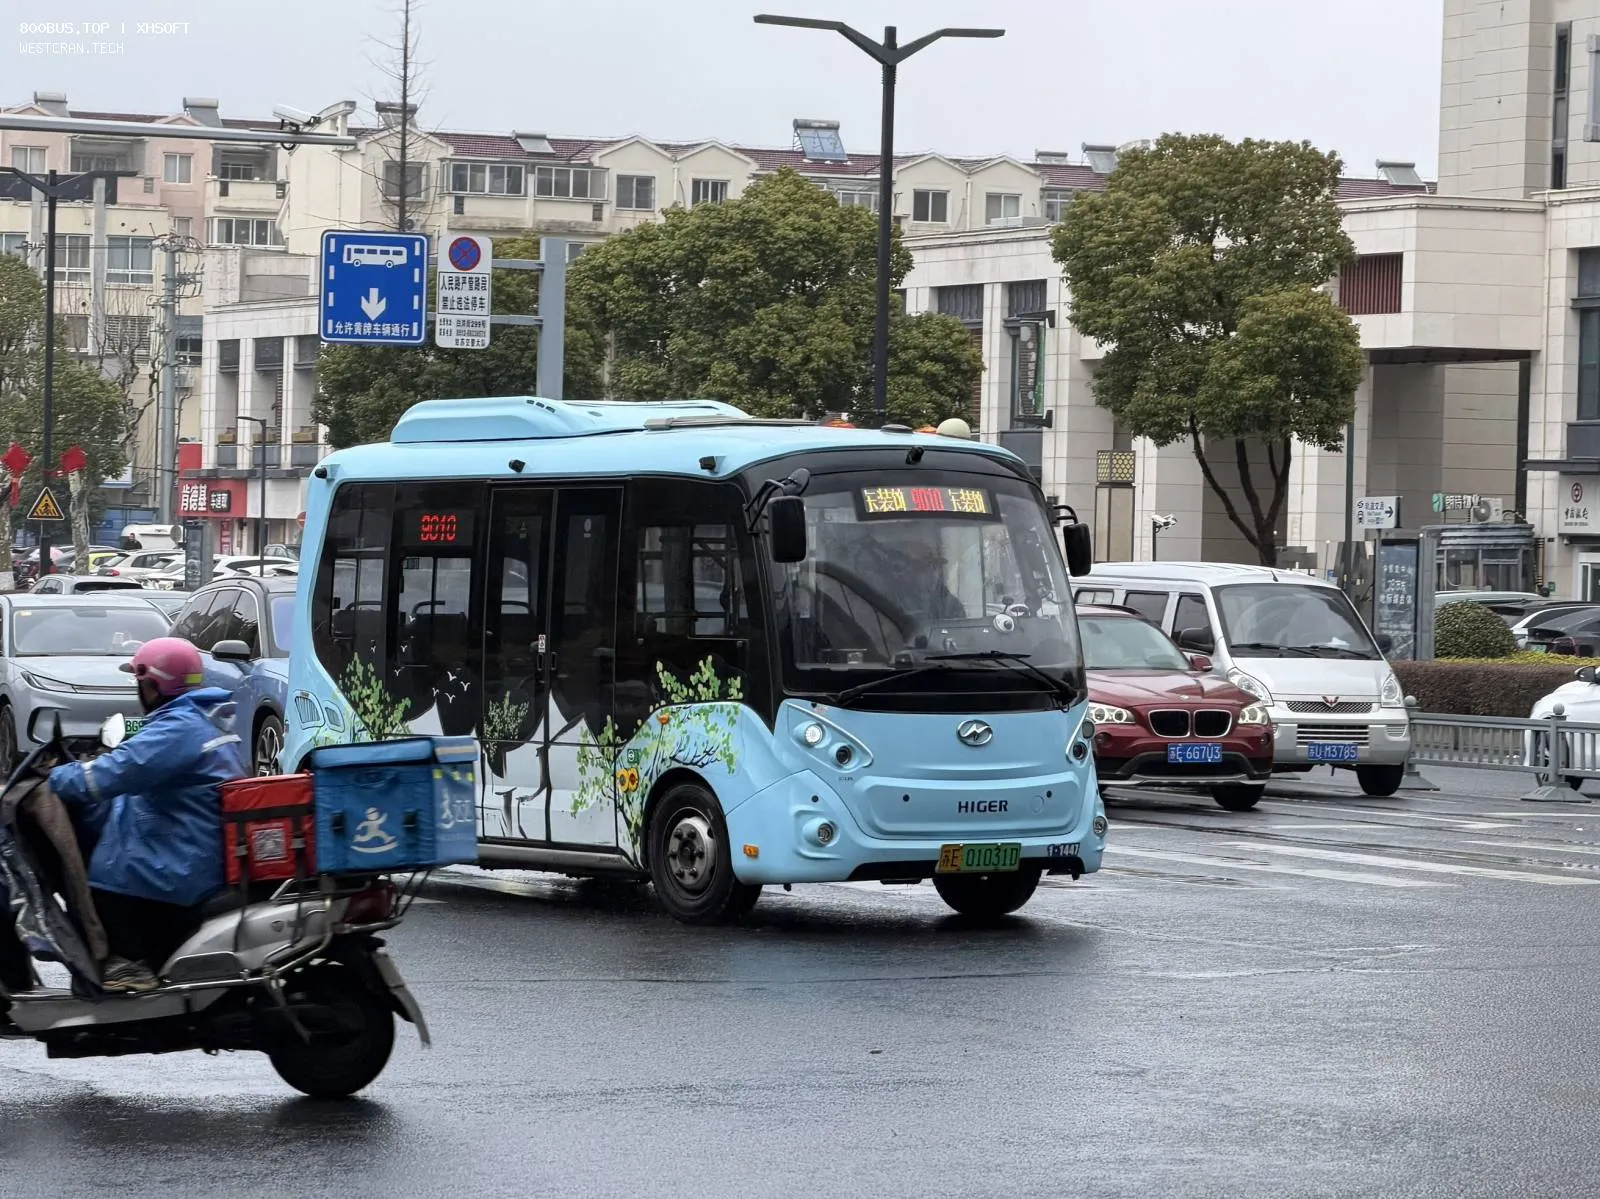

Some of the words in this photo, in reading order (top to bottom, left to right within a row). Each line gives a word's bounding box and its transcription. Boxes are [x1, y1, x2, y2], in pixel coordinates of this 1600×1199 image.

[440, 275, 488, 291] 人民路严管路段
[441, 295, 486, 311] 禁止违法停车
[334, 321, 410, 337] 允许黄牌车辆通行
[181, 483, 208, 511] 肯德基
[420, 514, 457, 541] 9010
[958, 800, 1008, 813] HIGER
